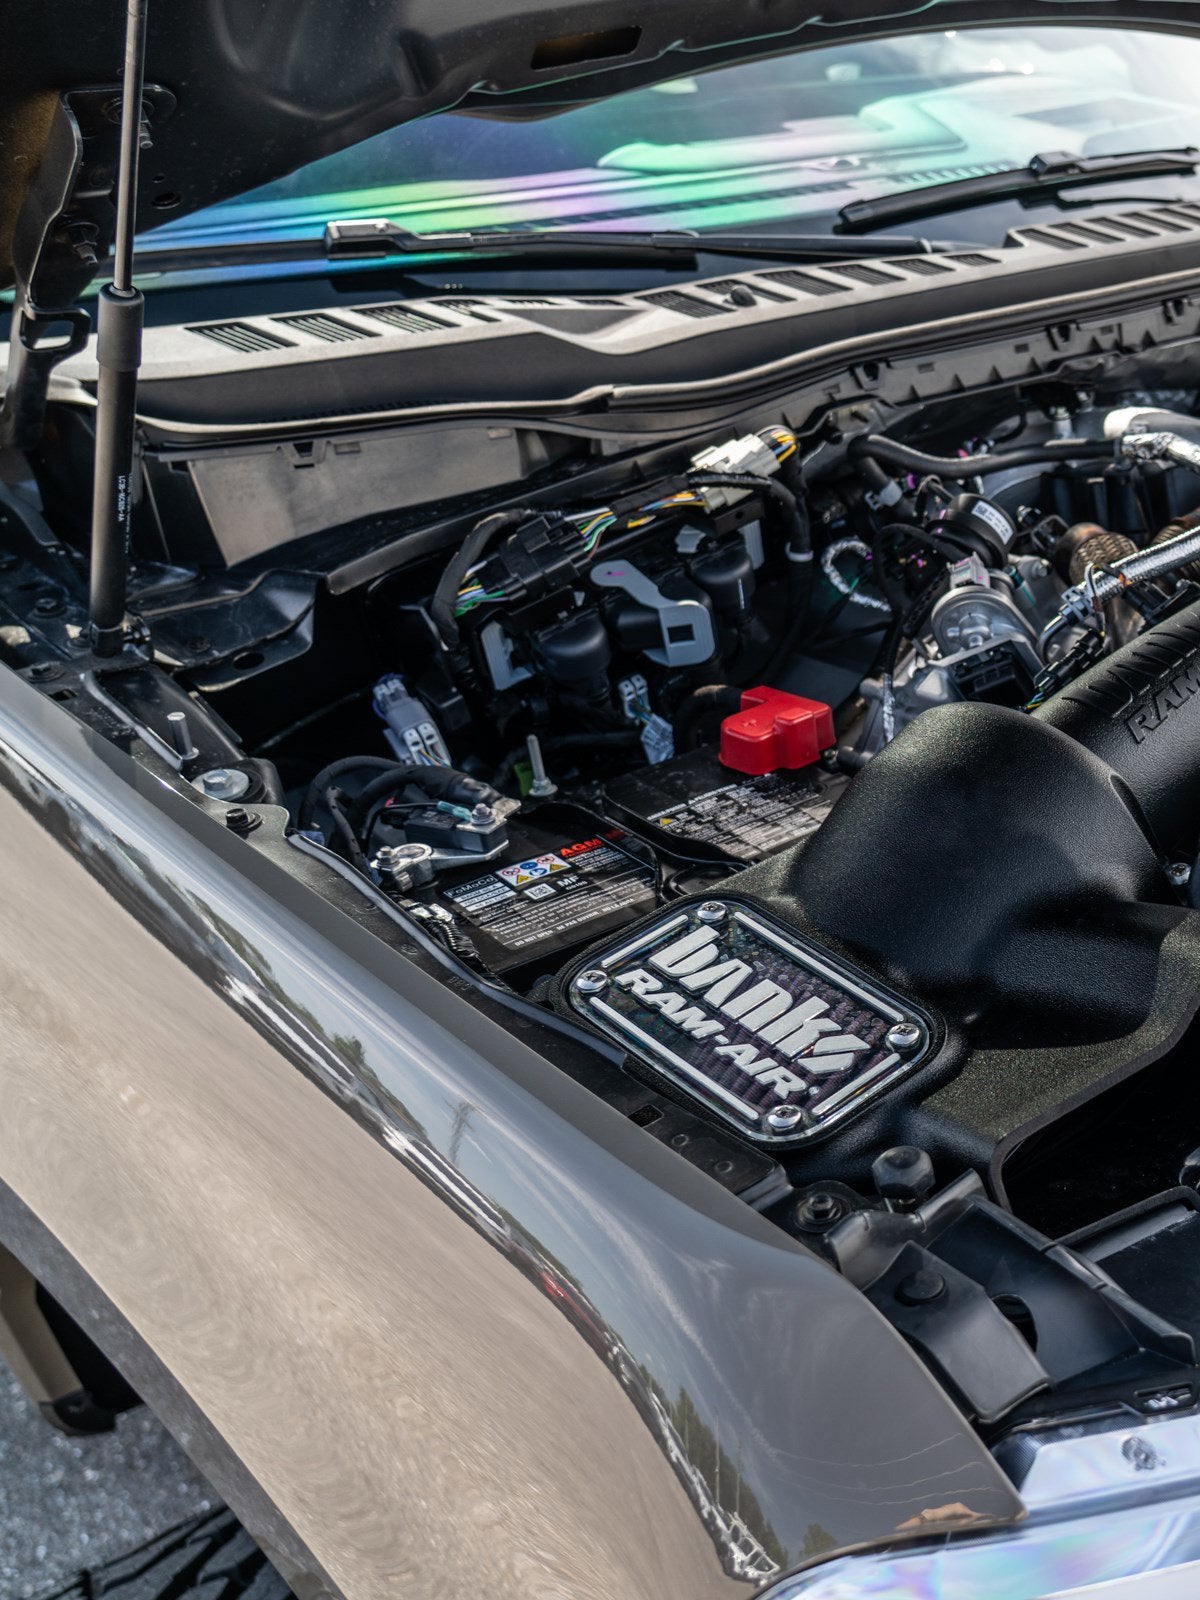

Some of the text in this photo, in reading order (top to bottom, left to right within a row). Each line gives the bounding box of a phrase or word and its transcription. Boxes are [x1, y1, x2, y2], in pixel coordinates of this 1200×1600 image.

[561, 838, 603, 856] AGM
[447, 877, 494, 897] FoMoCo
[557, 875, 579, 887] MF
[614, 968, 808, 1100] RAM-AIR
